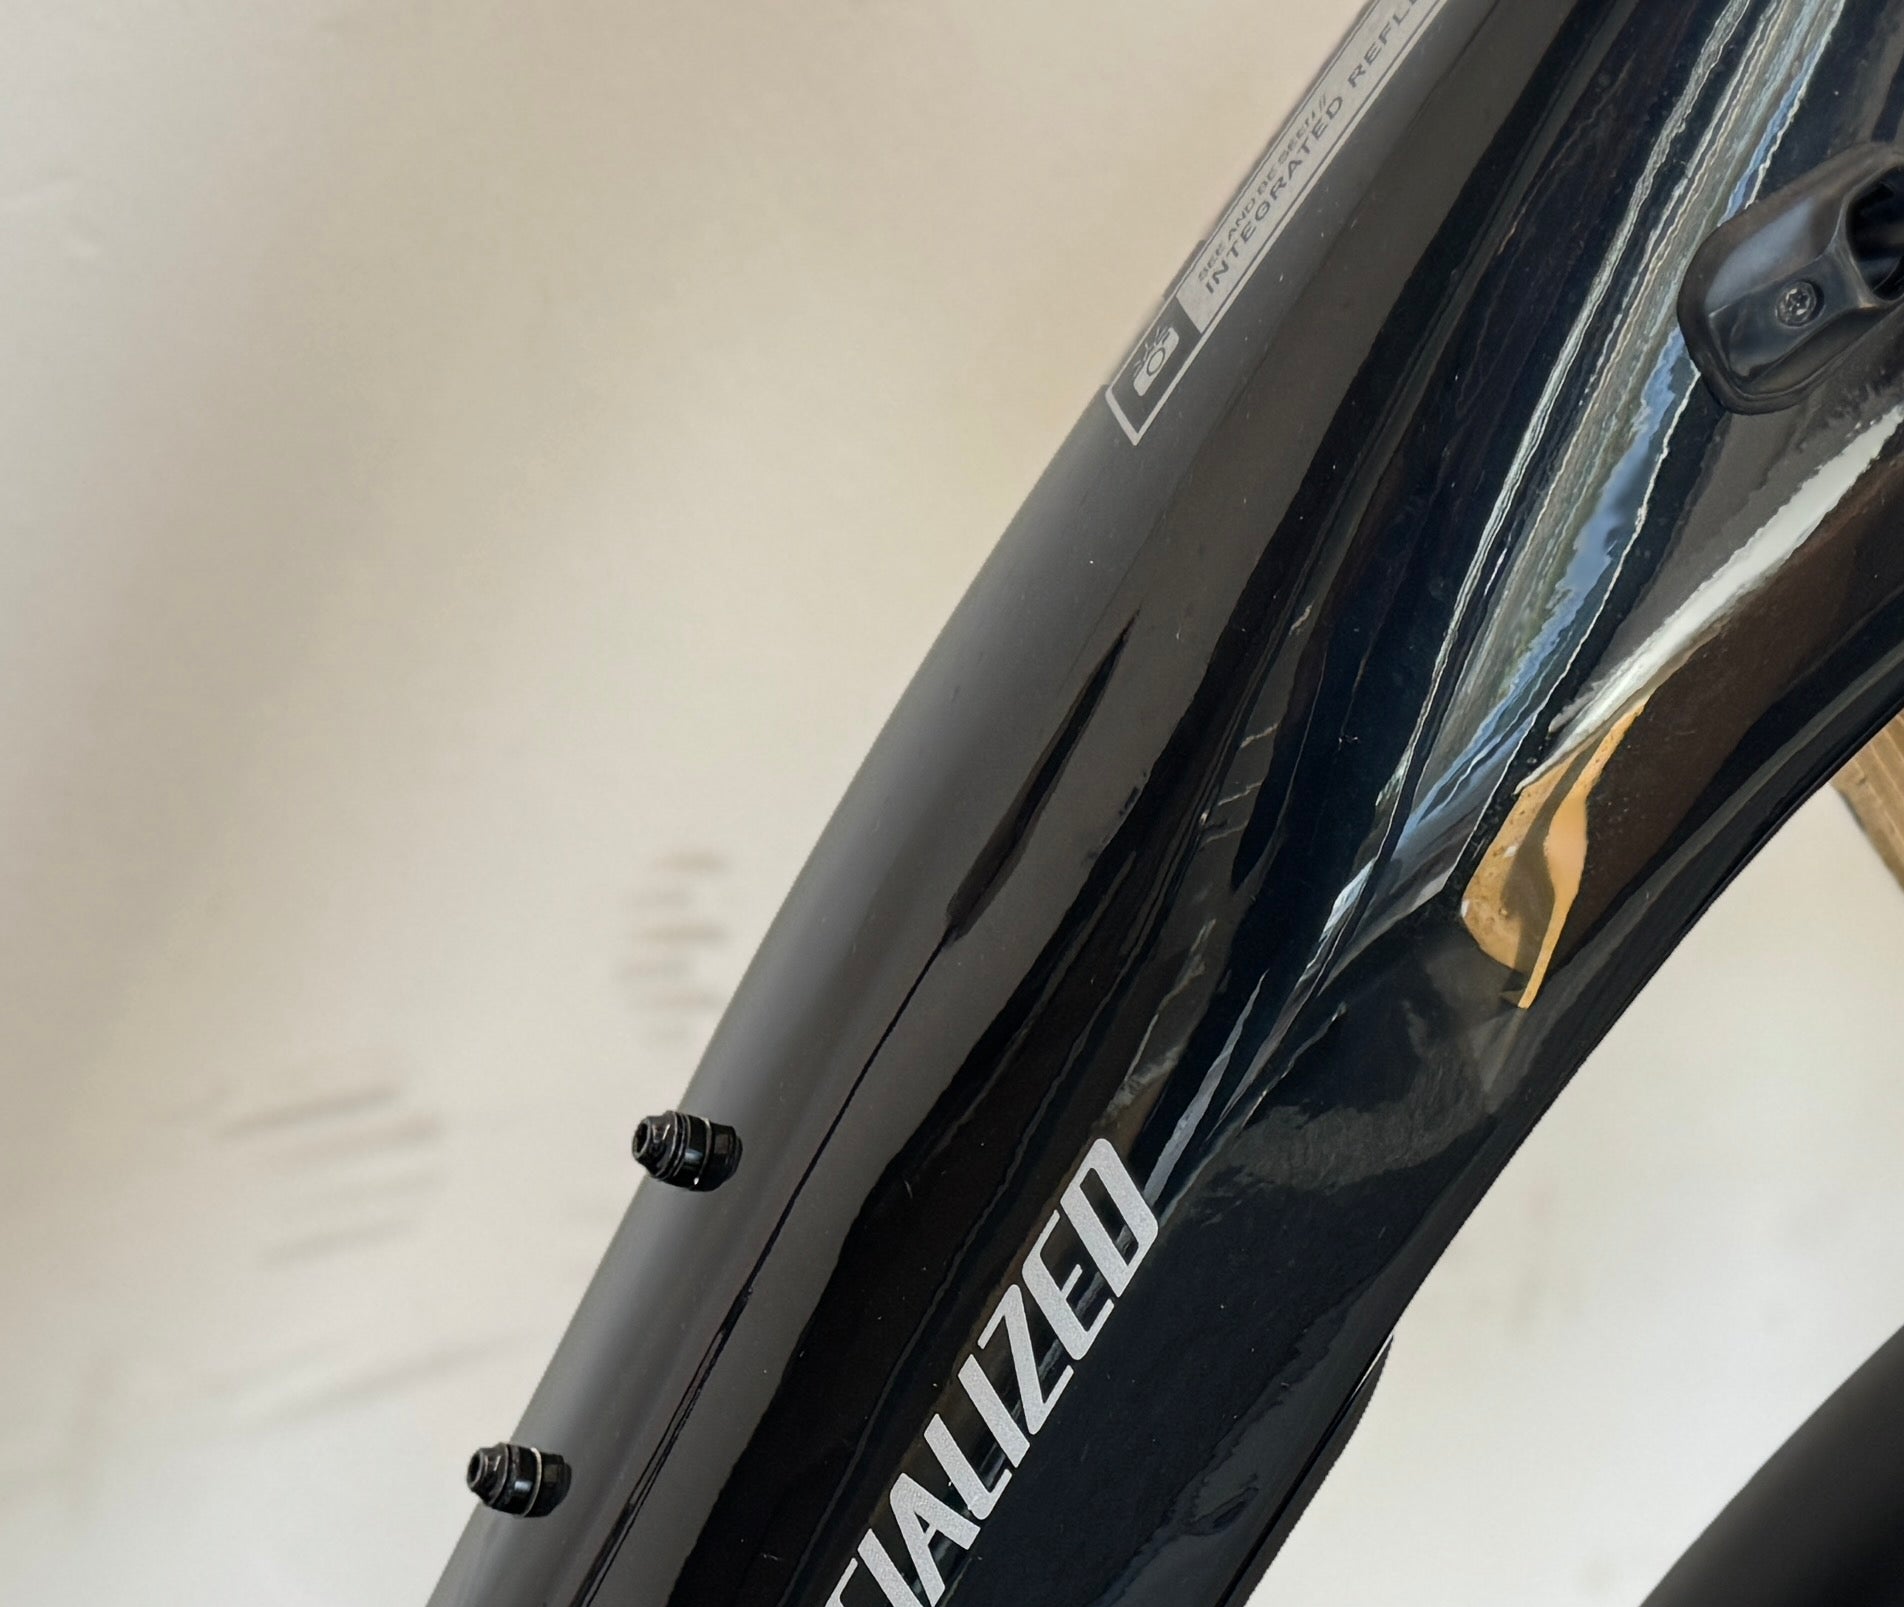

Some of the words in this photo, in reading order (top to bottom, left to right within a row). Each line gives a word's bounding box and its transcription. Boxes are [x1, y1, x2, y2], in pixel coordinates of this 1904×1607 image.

[1205, 96, 1344, 294] INTEGRATED
[1348, 0, 1418, 88] REFL
[1228, 197, 1256, 241] AND
